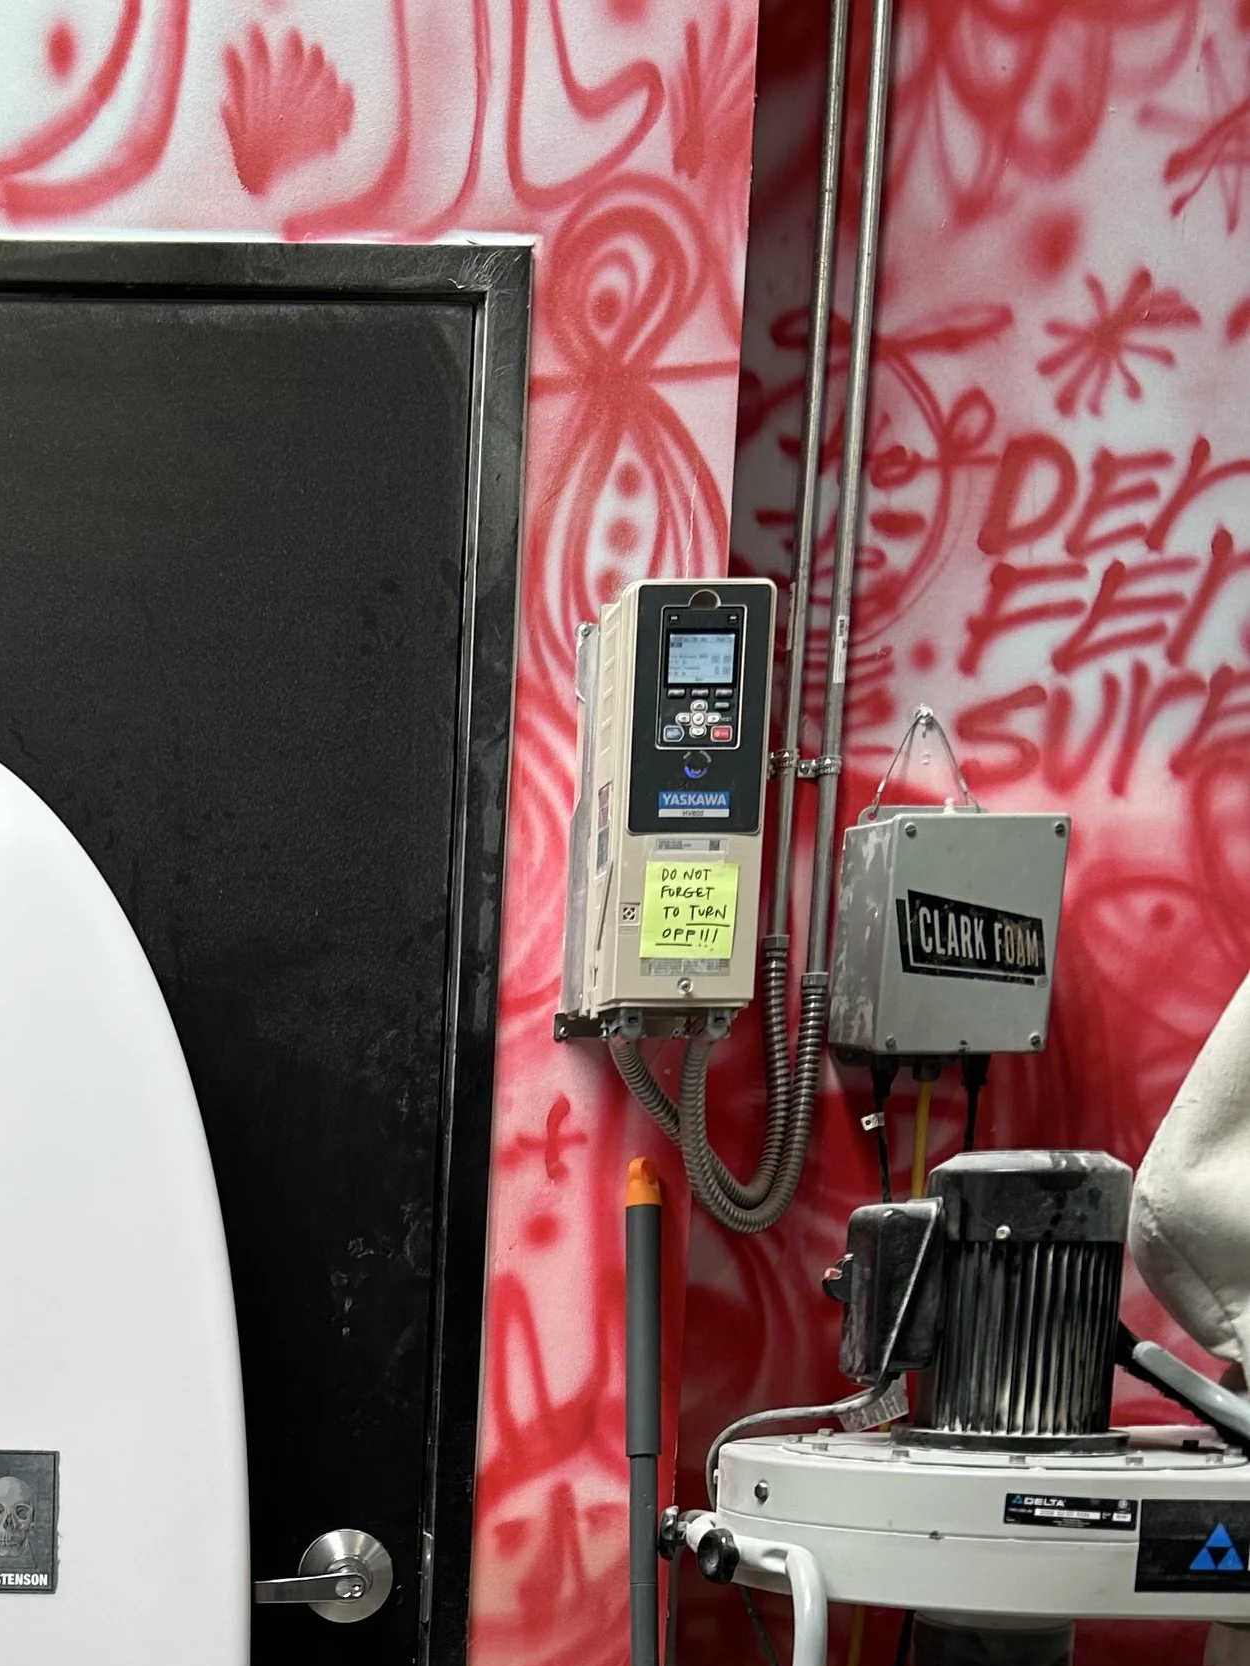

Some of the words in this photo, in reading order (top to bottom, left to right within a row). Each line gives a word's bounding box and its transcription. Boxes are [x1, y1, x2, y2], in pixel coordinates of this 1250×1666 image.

[662, 793, 727, 806] YASKAWA
[661, 868, 677, 882] DO
[683, 868, 712, 881] NOT
[660, 885, 715, 900] FORGET
[663, 906, 680, 920] TO
[689, 904, 727, 921] TURN
[918, 906, 988, 961] CLARK
[993, 922, 1040, 968] FOAM
[1023, 1496, 1065, 1508] DELTA
